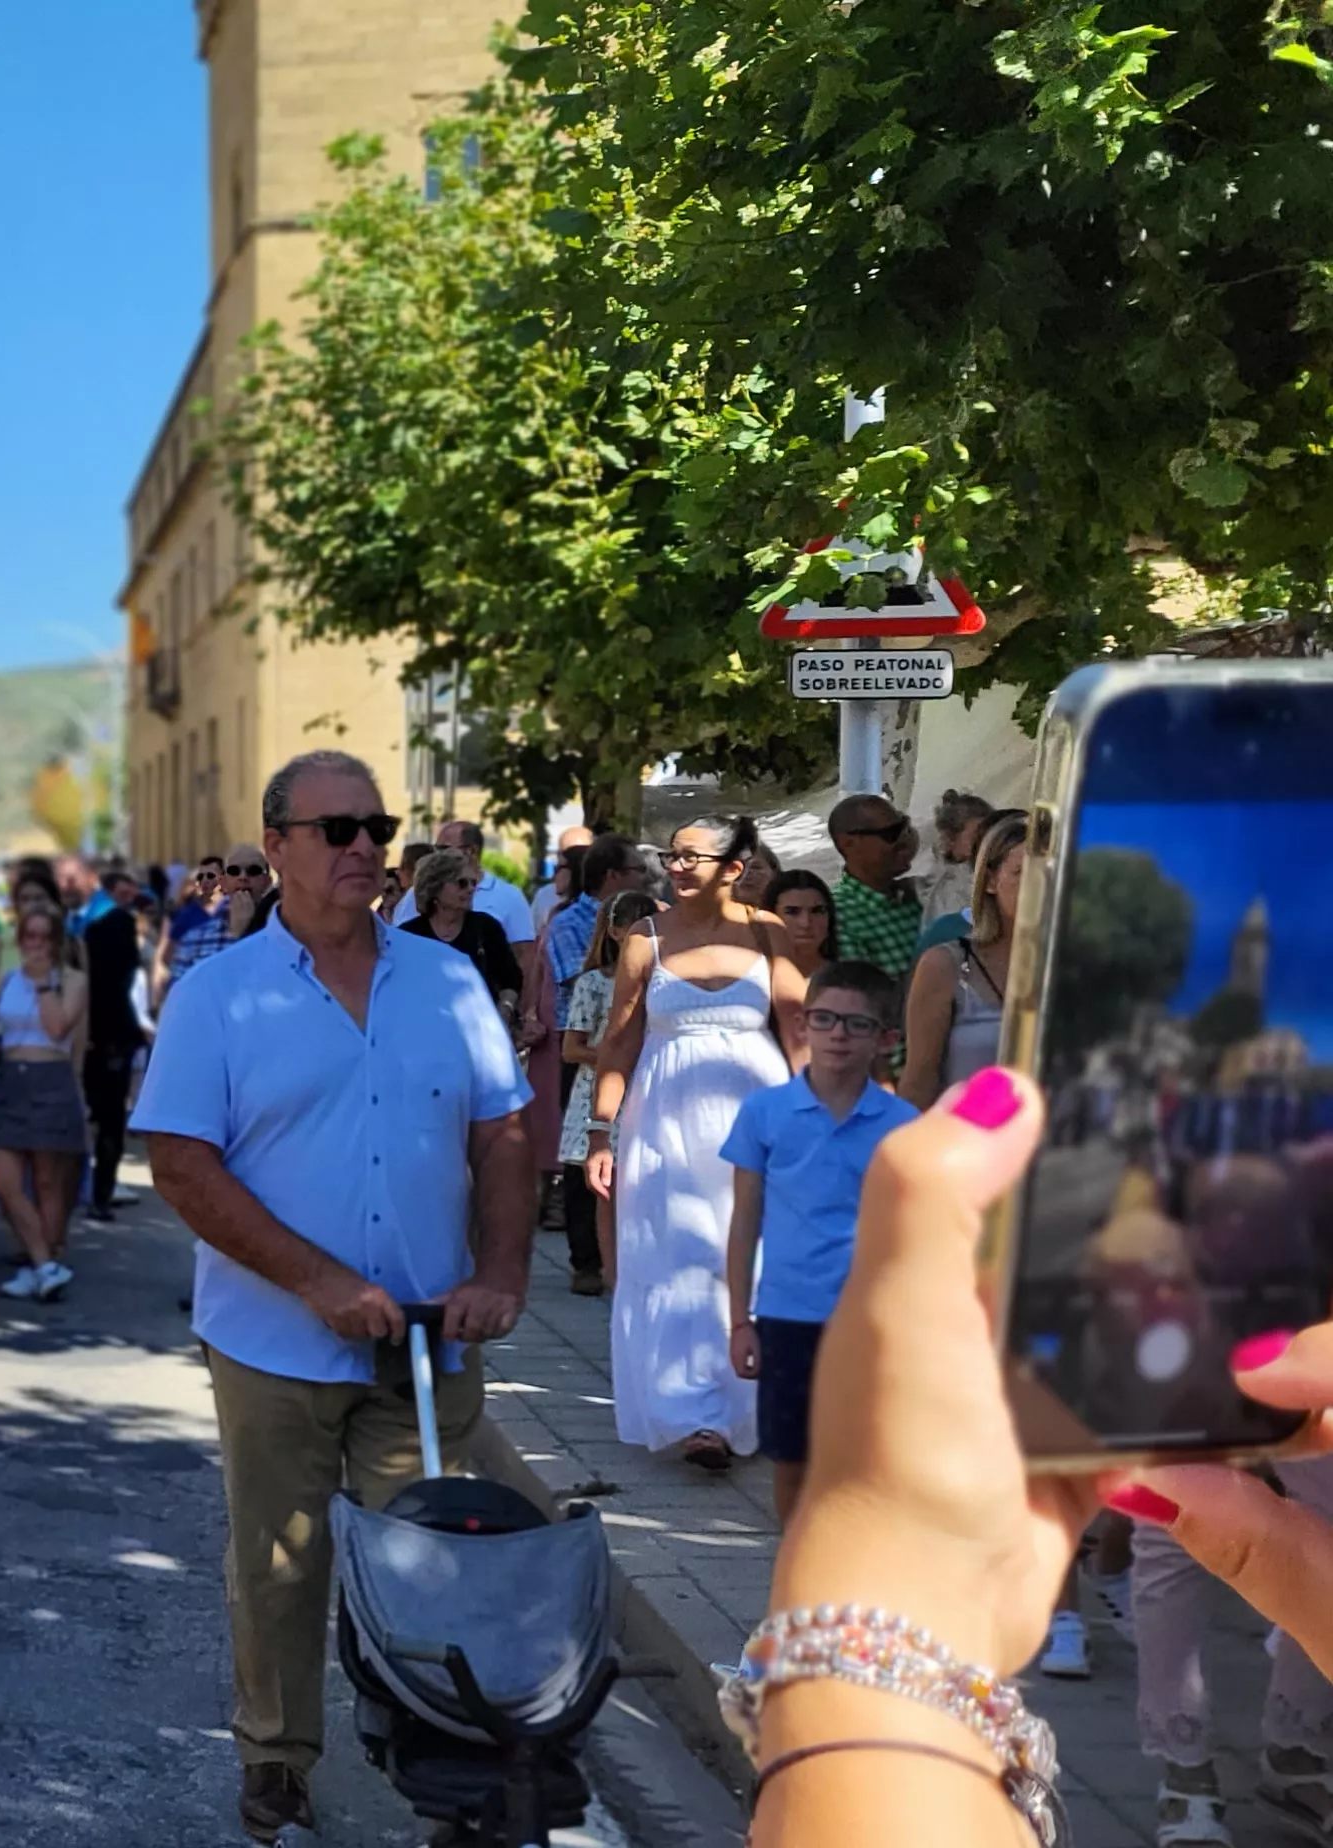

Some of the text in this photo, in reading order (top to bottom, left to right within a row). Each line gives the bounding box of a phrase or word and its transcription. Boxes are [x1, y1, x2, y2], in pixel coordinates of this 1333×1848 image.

[798, 658, 945, 671] PASO PEATONAL
[799, 677, 944, 691] SOBREELEVADO
